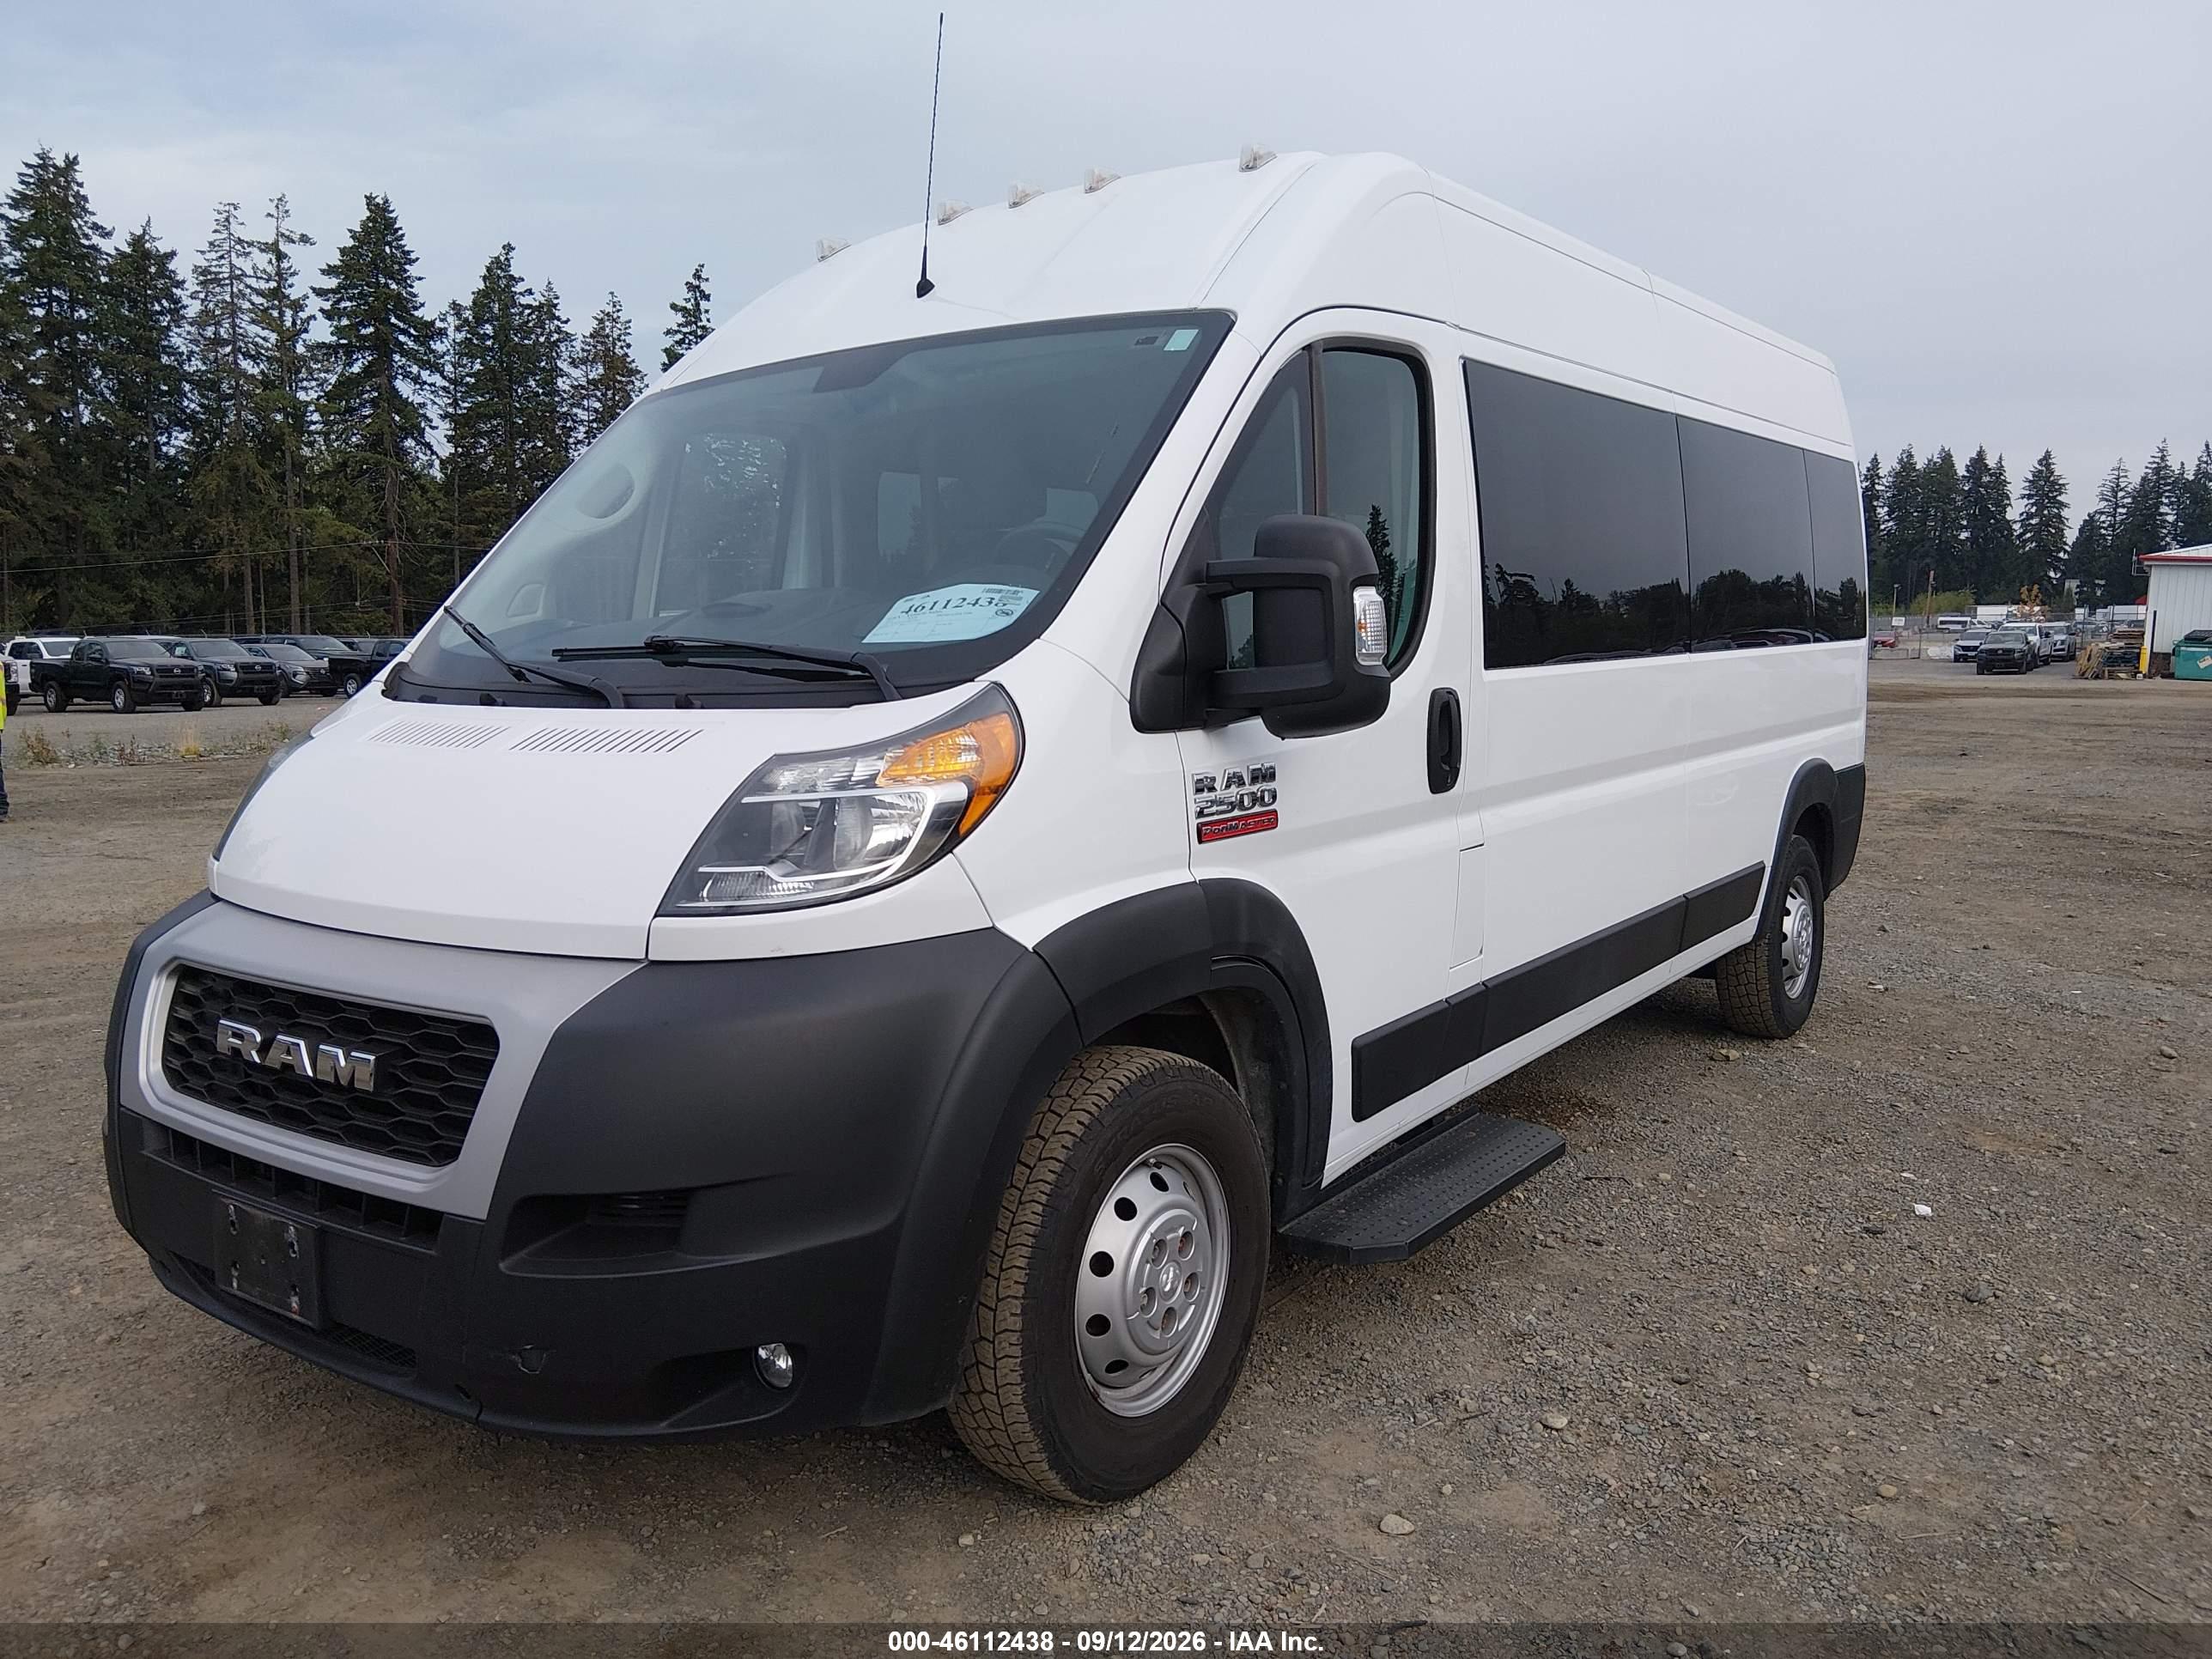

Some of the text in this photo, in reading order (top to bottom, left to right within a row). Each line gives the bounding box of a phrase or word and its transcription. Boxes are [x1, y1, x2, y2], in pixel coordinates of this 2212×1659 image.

[1191, 761, 1276, 795] RAM
[1194, 785, 1278, 820] 2500
[216, 1019, 376, 1092] RAM
